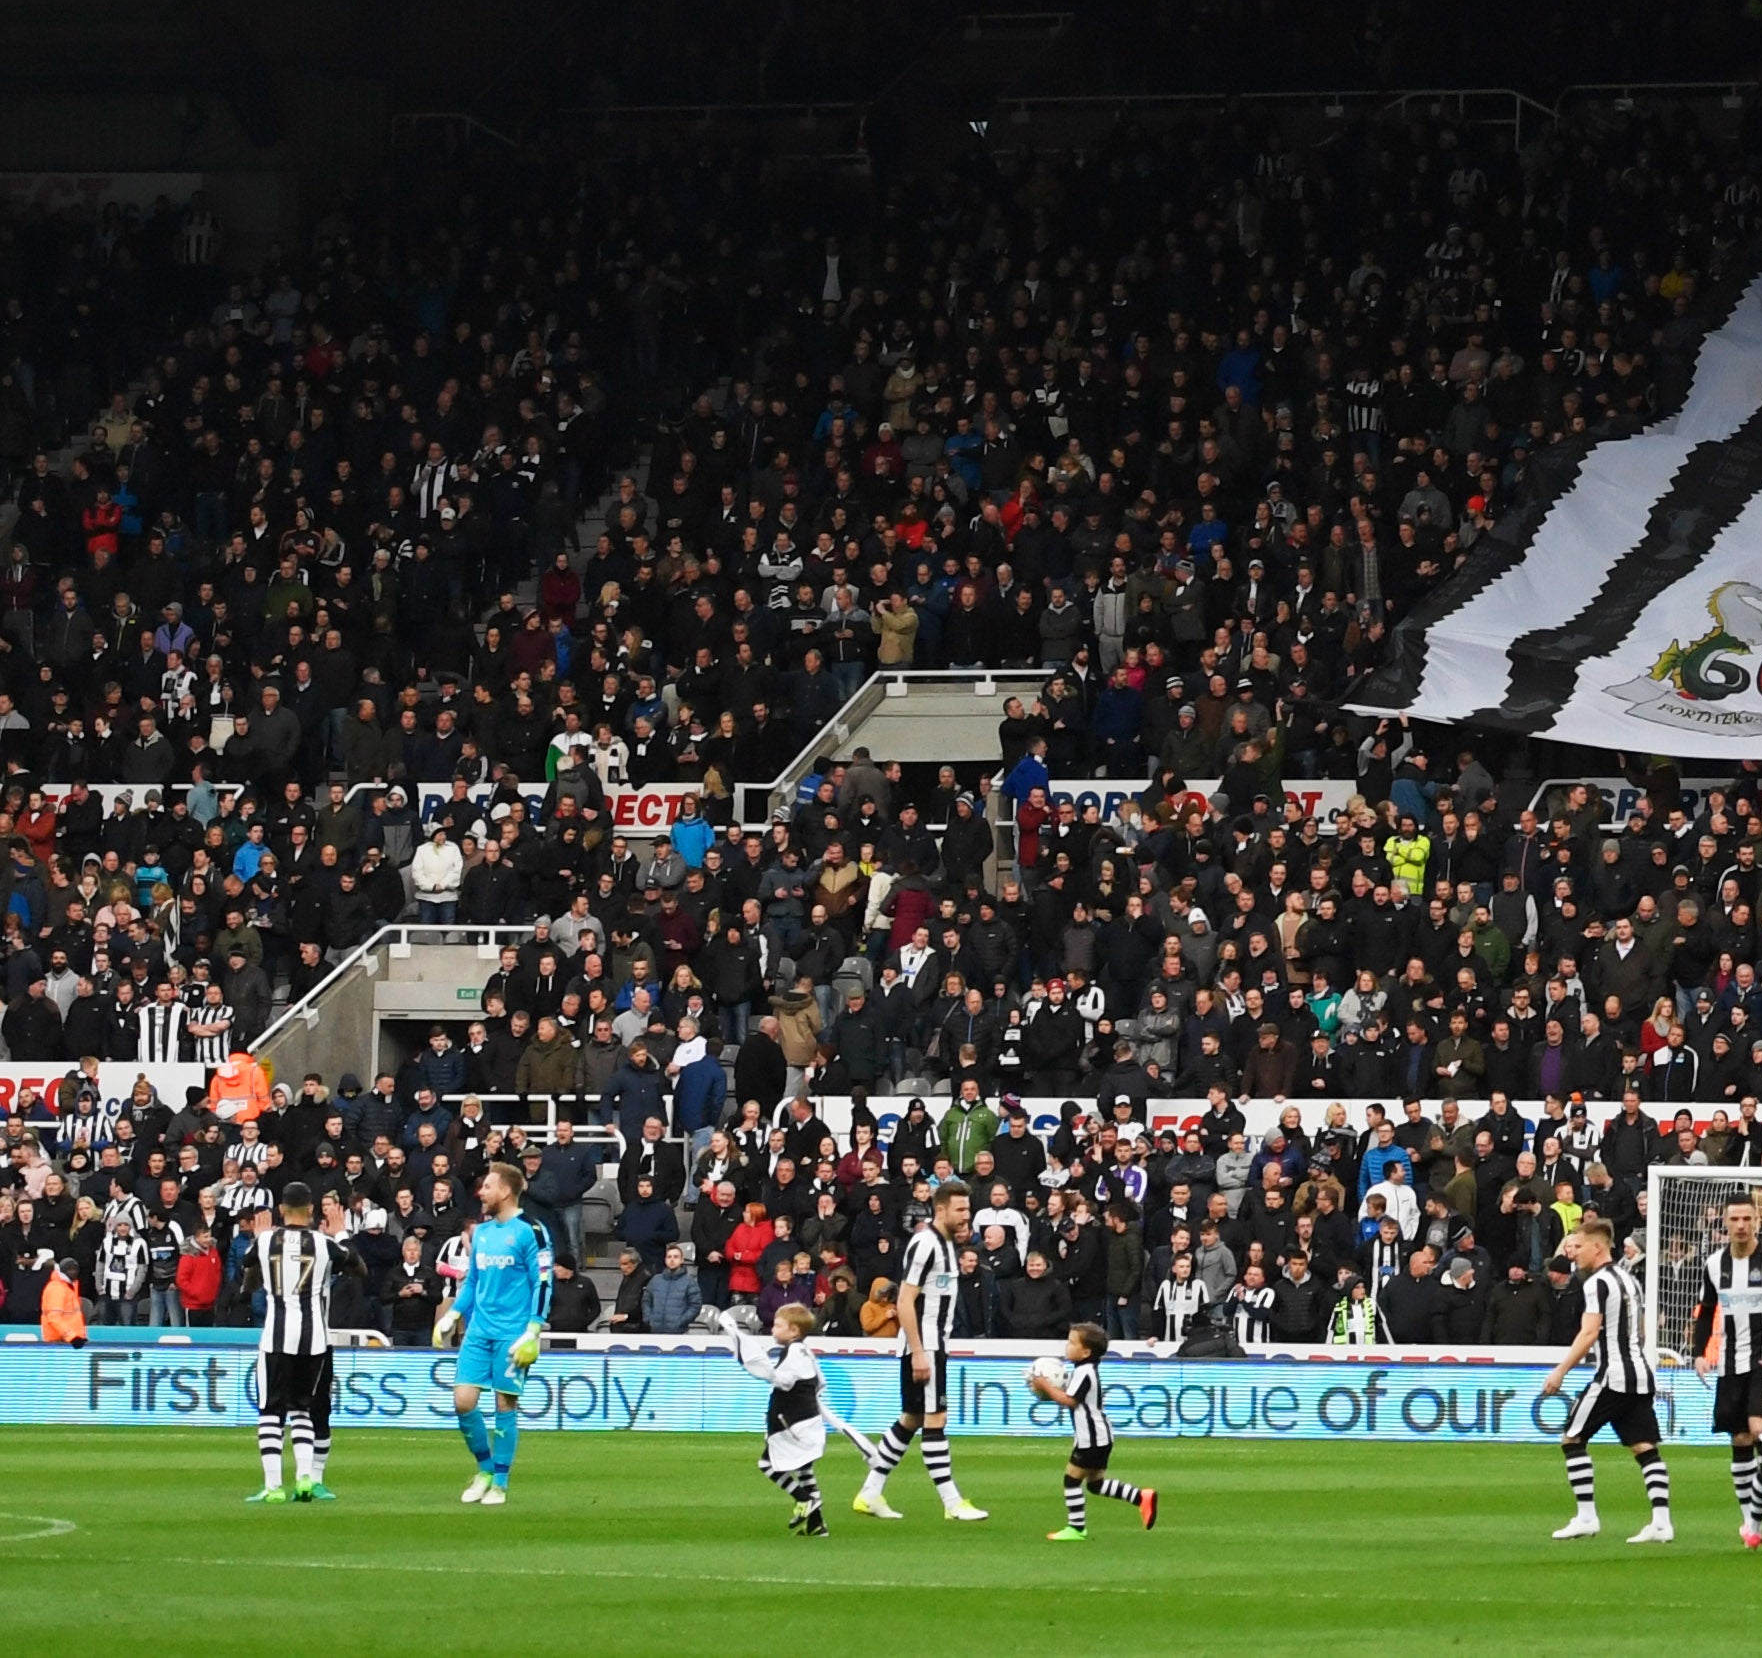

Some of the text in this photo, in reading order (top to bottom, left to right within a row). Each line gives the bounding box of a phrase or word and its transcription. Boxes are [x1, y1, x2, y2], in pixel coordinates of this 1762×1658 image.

[273, 1254, 318, 1297] 17
[89, 1352, 228, 1413] First
[428, 1355, 656, 1430] Spply.
[958, 1365, 1010, 1426] In
[1101, 1383, 1300, 1438] eague
[1317, 1370, 1389, 1434] of
[1402, 1387, 1517, 1434] our
